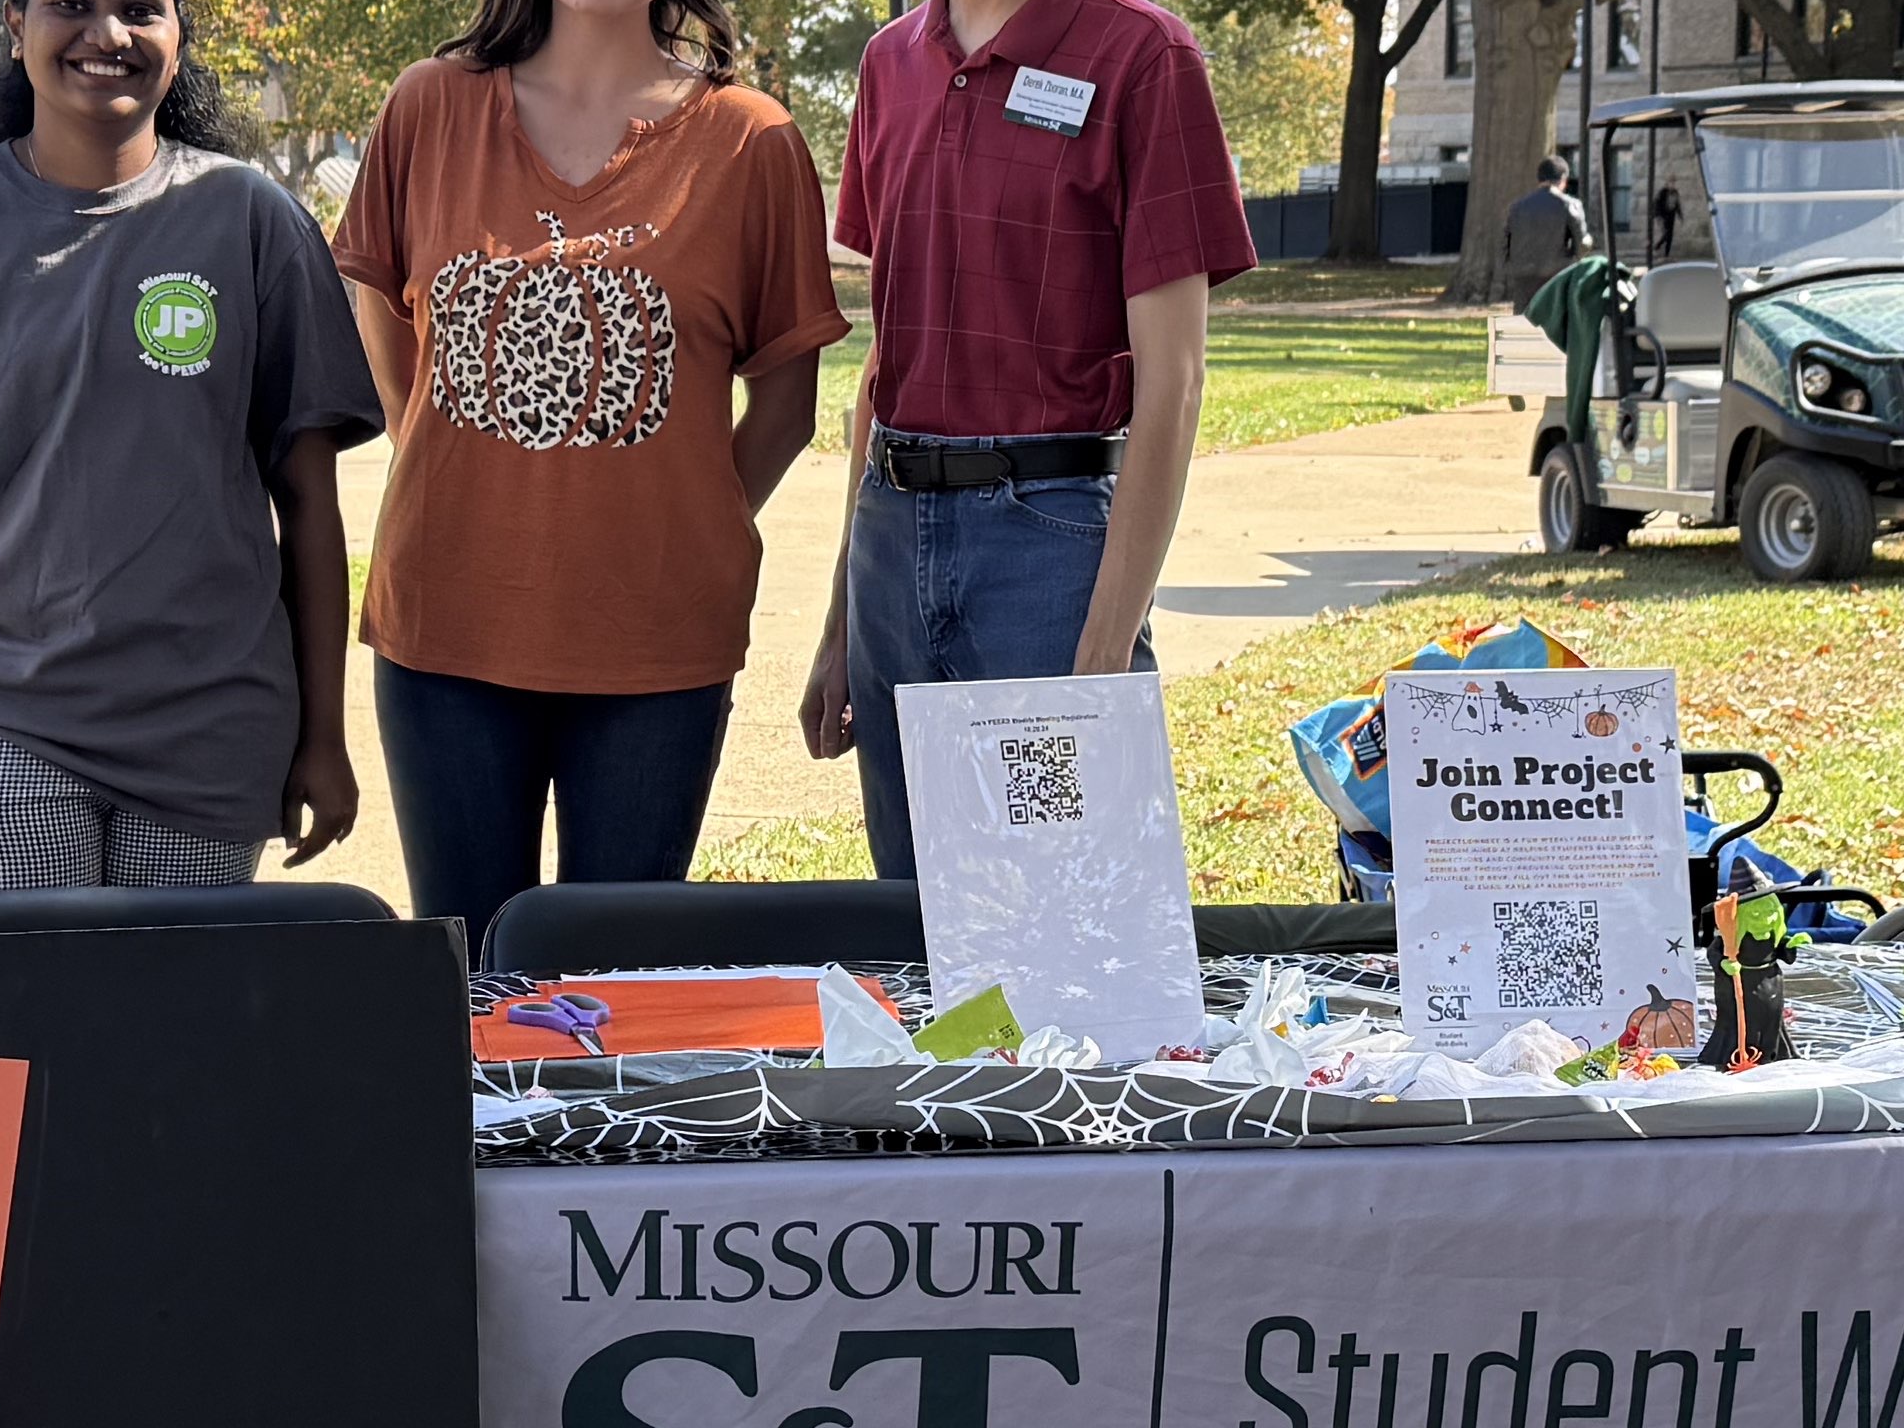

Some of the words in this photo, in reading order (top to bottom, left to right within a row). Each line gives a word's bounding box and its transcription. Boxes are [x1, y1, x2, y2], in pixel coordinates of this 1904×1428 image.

[152, 304, 205, 338] JP
[1416, 758, 1503, 788] Join
[1514, 755, 1656, 793] Project
[1450, 790, 1625, 822] Connect!
[1427, 995, 1472, 1022] S&T
[558, 1209, 1084, 1303] MISSOURI
